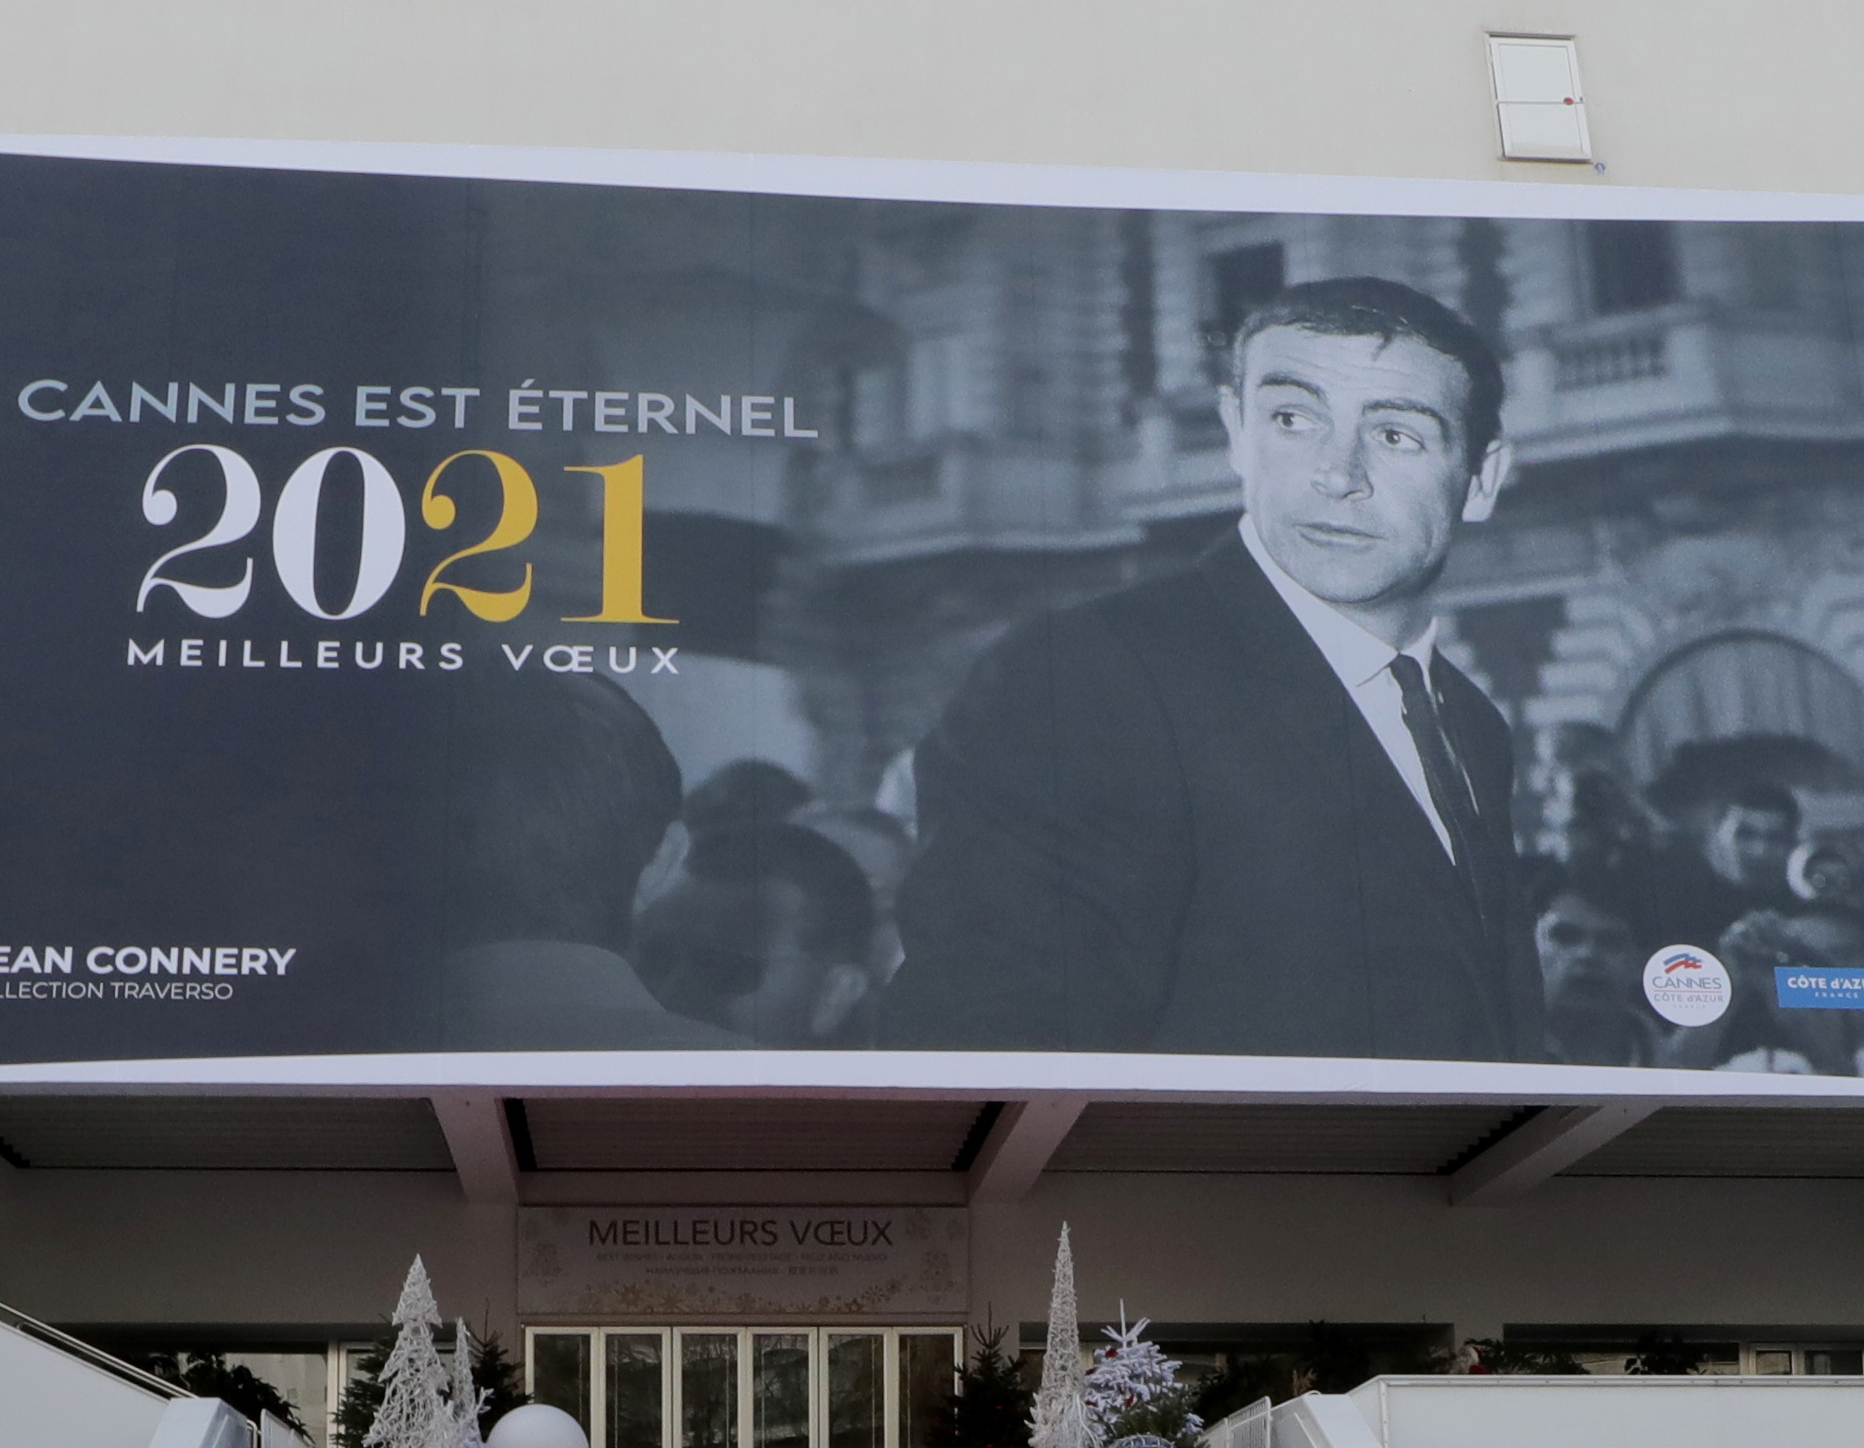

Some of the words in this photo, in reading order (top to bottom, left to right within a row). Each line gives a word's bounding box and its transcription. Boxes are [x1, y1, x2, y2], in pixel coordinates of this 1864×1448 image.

[17, 379, 327, 427] CANNES
[355, 386, 480, 430] EST
[507, 379, 819, 439] ÉTERNEL
[136, 444, 680, 624] 2021
[127, 638, 464, 672] MEILLEURS
[501, 643, 680, 675] VŒUX
[86, 946, 297, 977] CONNERY
[109, 981, 234, 1001] TRAVERSO
[1652, 976, 1723, 990] CANNES
[1787, 975, 1826, 990] CÔTE
[1653, 992, 1686, 1003] CÔTE
[589, 1219, 778, 1247] MEILLEURS
[789, 1219, 894, 1247] VŒUX
